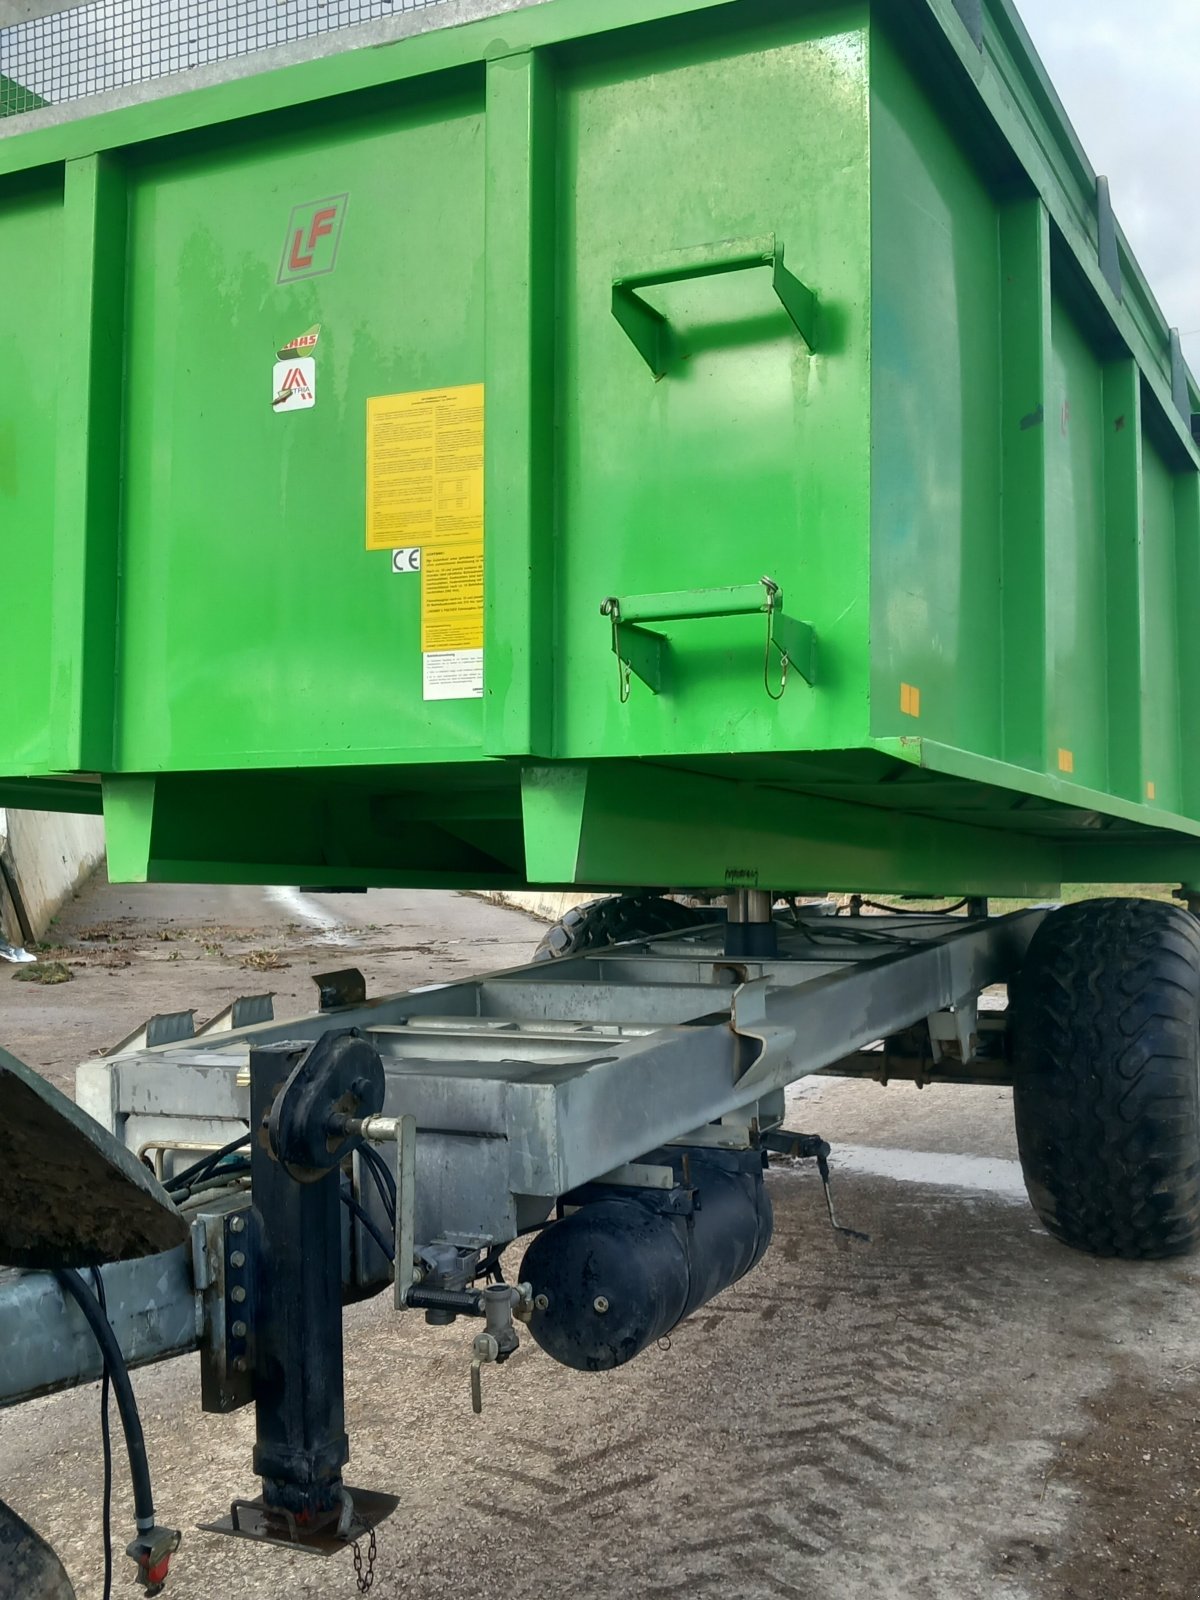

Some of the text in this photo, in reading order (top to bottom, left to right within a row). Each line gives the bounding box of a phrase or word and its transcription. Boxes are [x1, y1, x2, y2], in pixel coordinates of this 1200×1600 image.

[289, 207, 337, 270] LF
[284, 335, 316, 349] AAS
[393, 549, 419, 571] CE
